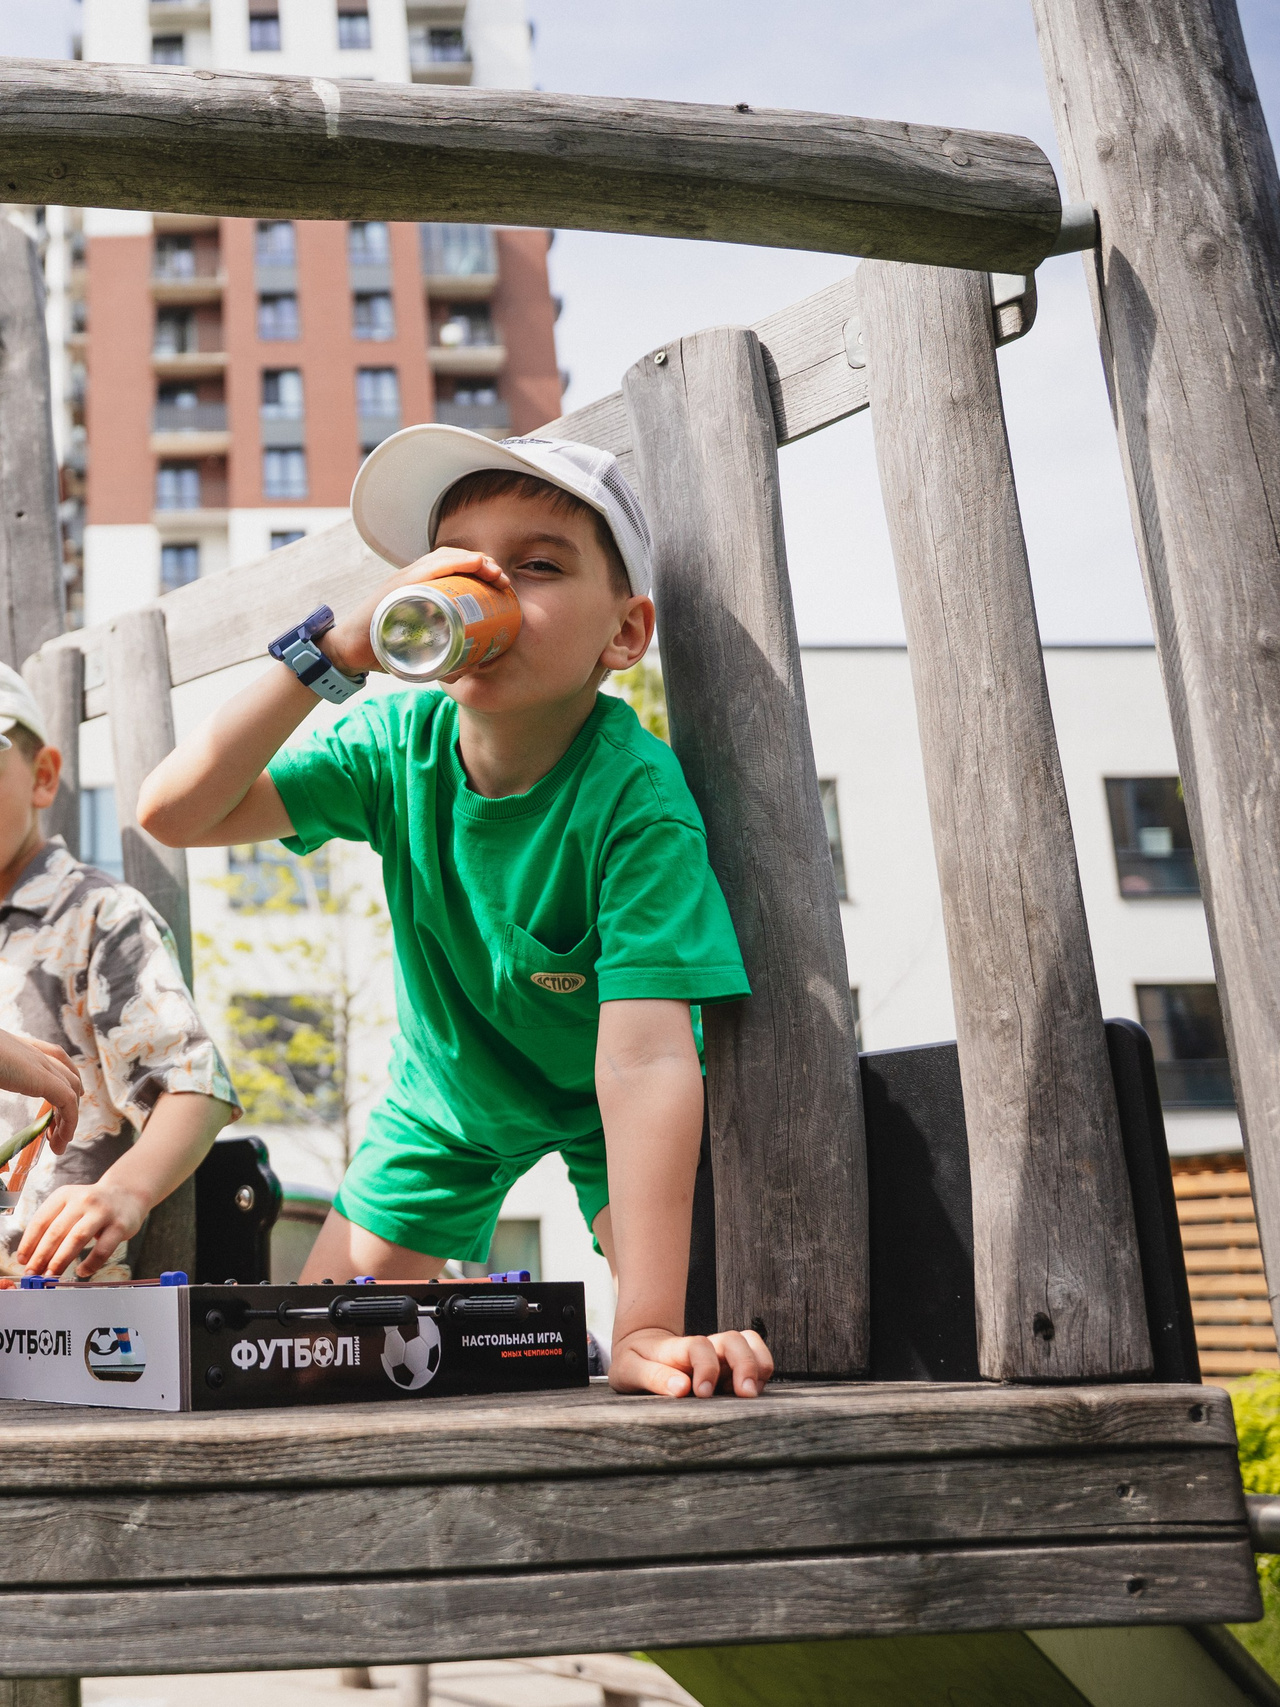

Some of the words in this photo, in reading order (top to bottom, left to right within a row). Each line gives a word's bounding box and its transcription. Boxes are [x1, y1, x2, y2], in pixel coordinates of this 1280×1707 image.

[353, 1335, 361, 1366] МИНИ
[461, 1333, 535, 1347] НАСТОЛЬНАЯ
[537, 1331, 563, 1344] ИГРА
[231, 1336, 353, 1370] ФУТБОЛ
[500, 1350, 522, 1358] ЮНЫХ
[523, 1348, 563, 1357] ЧЕМПИОНОВ
